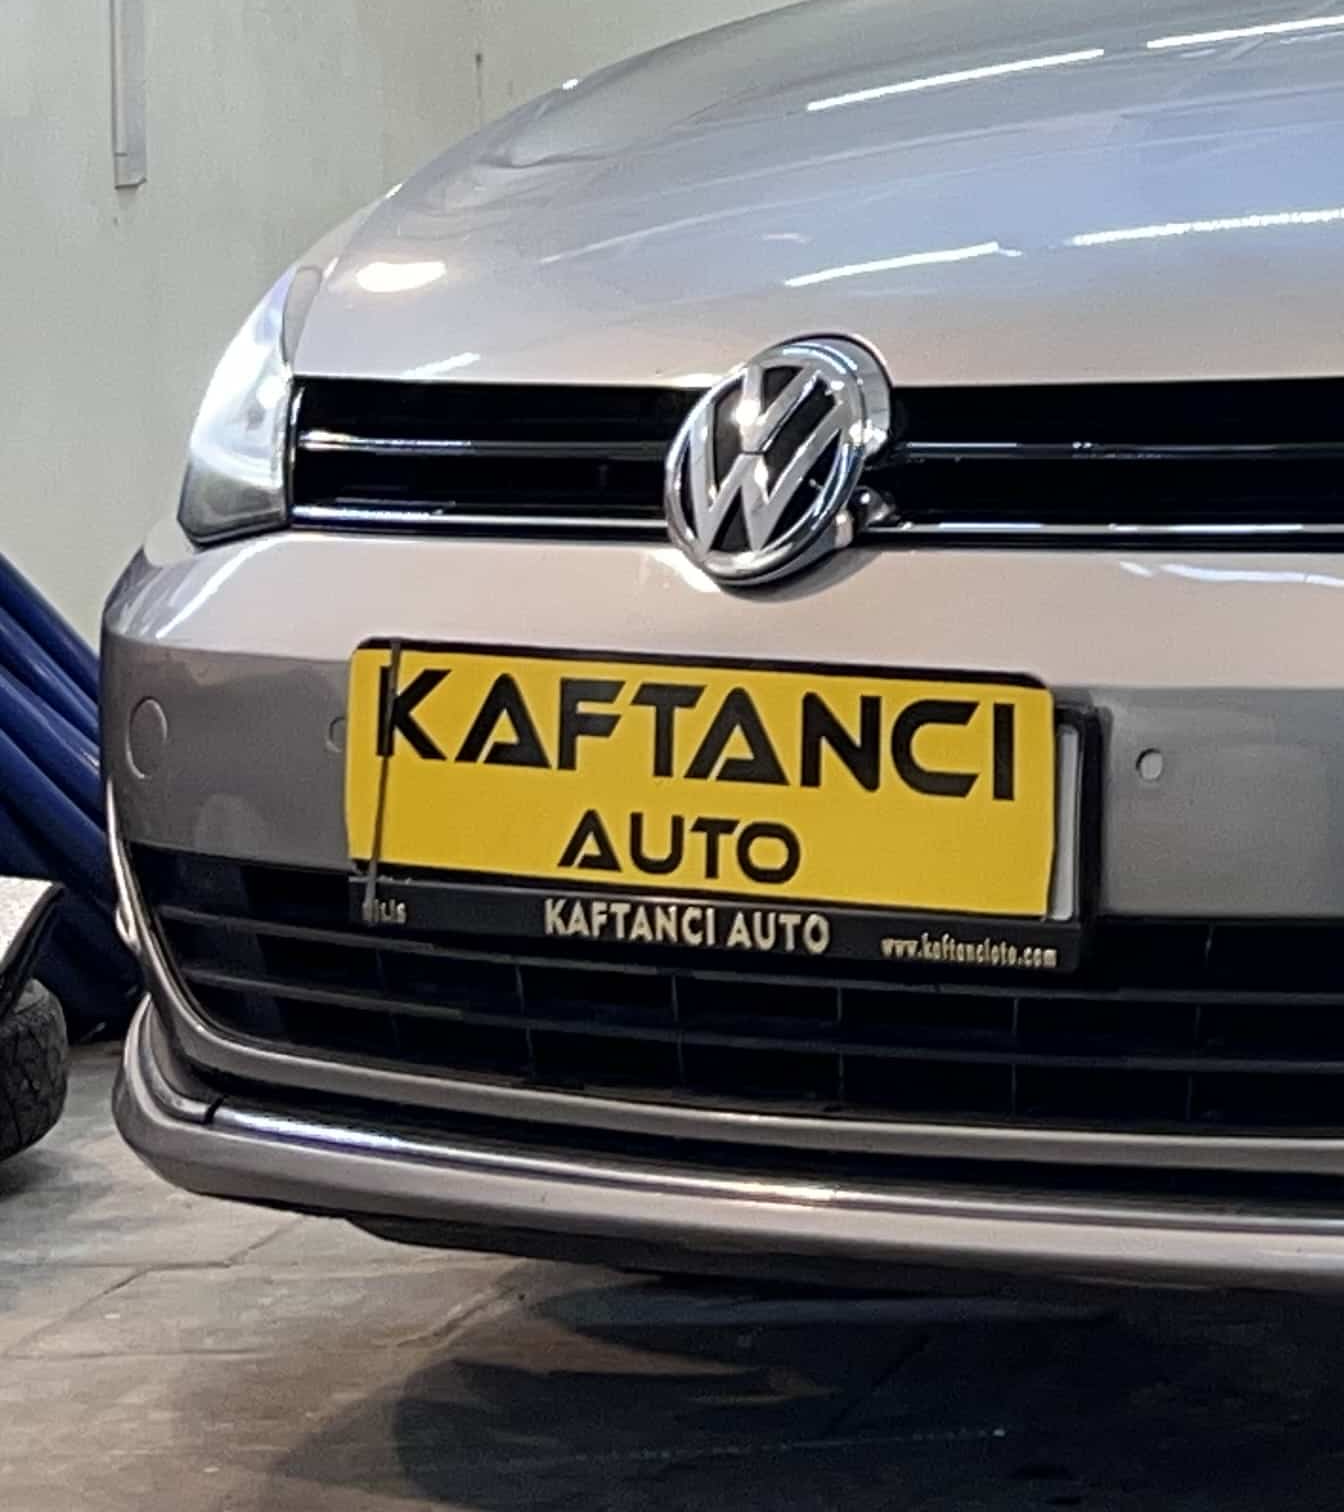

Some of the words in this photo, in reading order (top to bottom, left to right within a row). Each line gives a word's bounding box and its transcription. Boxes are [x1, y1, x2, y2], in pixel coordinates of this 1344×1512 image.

[376, 664, 1016, 801] KAFTANCI
[557, 808, 801, 884] AUTO
[544, 897, 716, 947] KAFTANCI
[726, 910, 831, 955] AUTO
